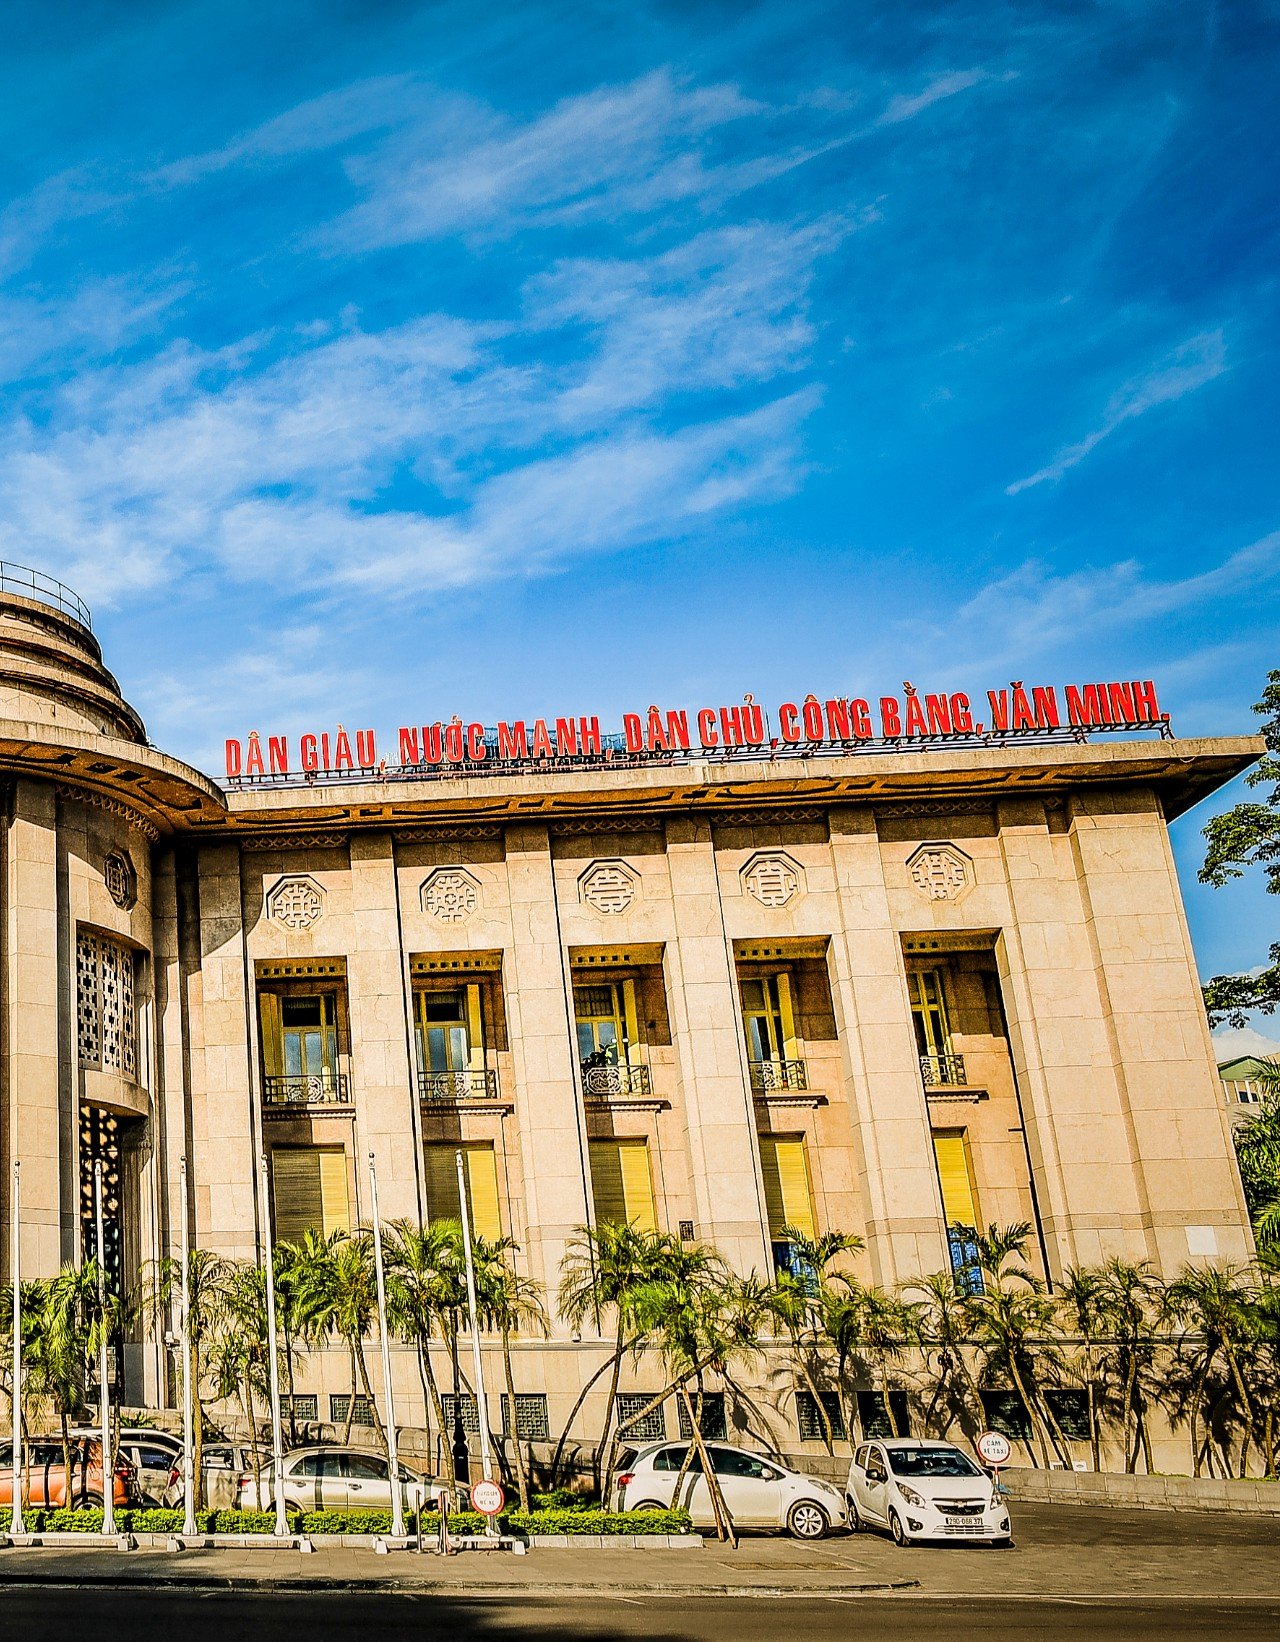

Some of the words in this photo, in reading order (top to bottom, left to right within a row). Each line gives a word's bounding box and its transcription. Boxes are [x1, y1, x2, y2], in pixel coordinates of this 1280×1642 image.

[225, 730, 288, 777] DÂN
[300, 723, 387, 774] GIÀU,
[398, 713, 486, 766] NƯỚC
[623, 705, 690, 752] DÂN
[779, 694, 872, 742] CÔNG
[880, 681, 984, 738] BẰNG,
[987, 681, 1060, 732] VĂN
[1065, 680, 1170, 727] MINH.
